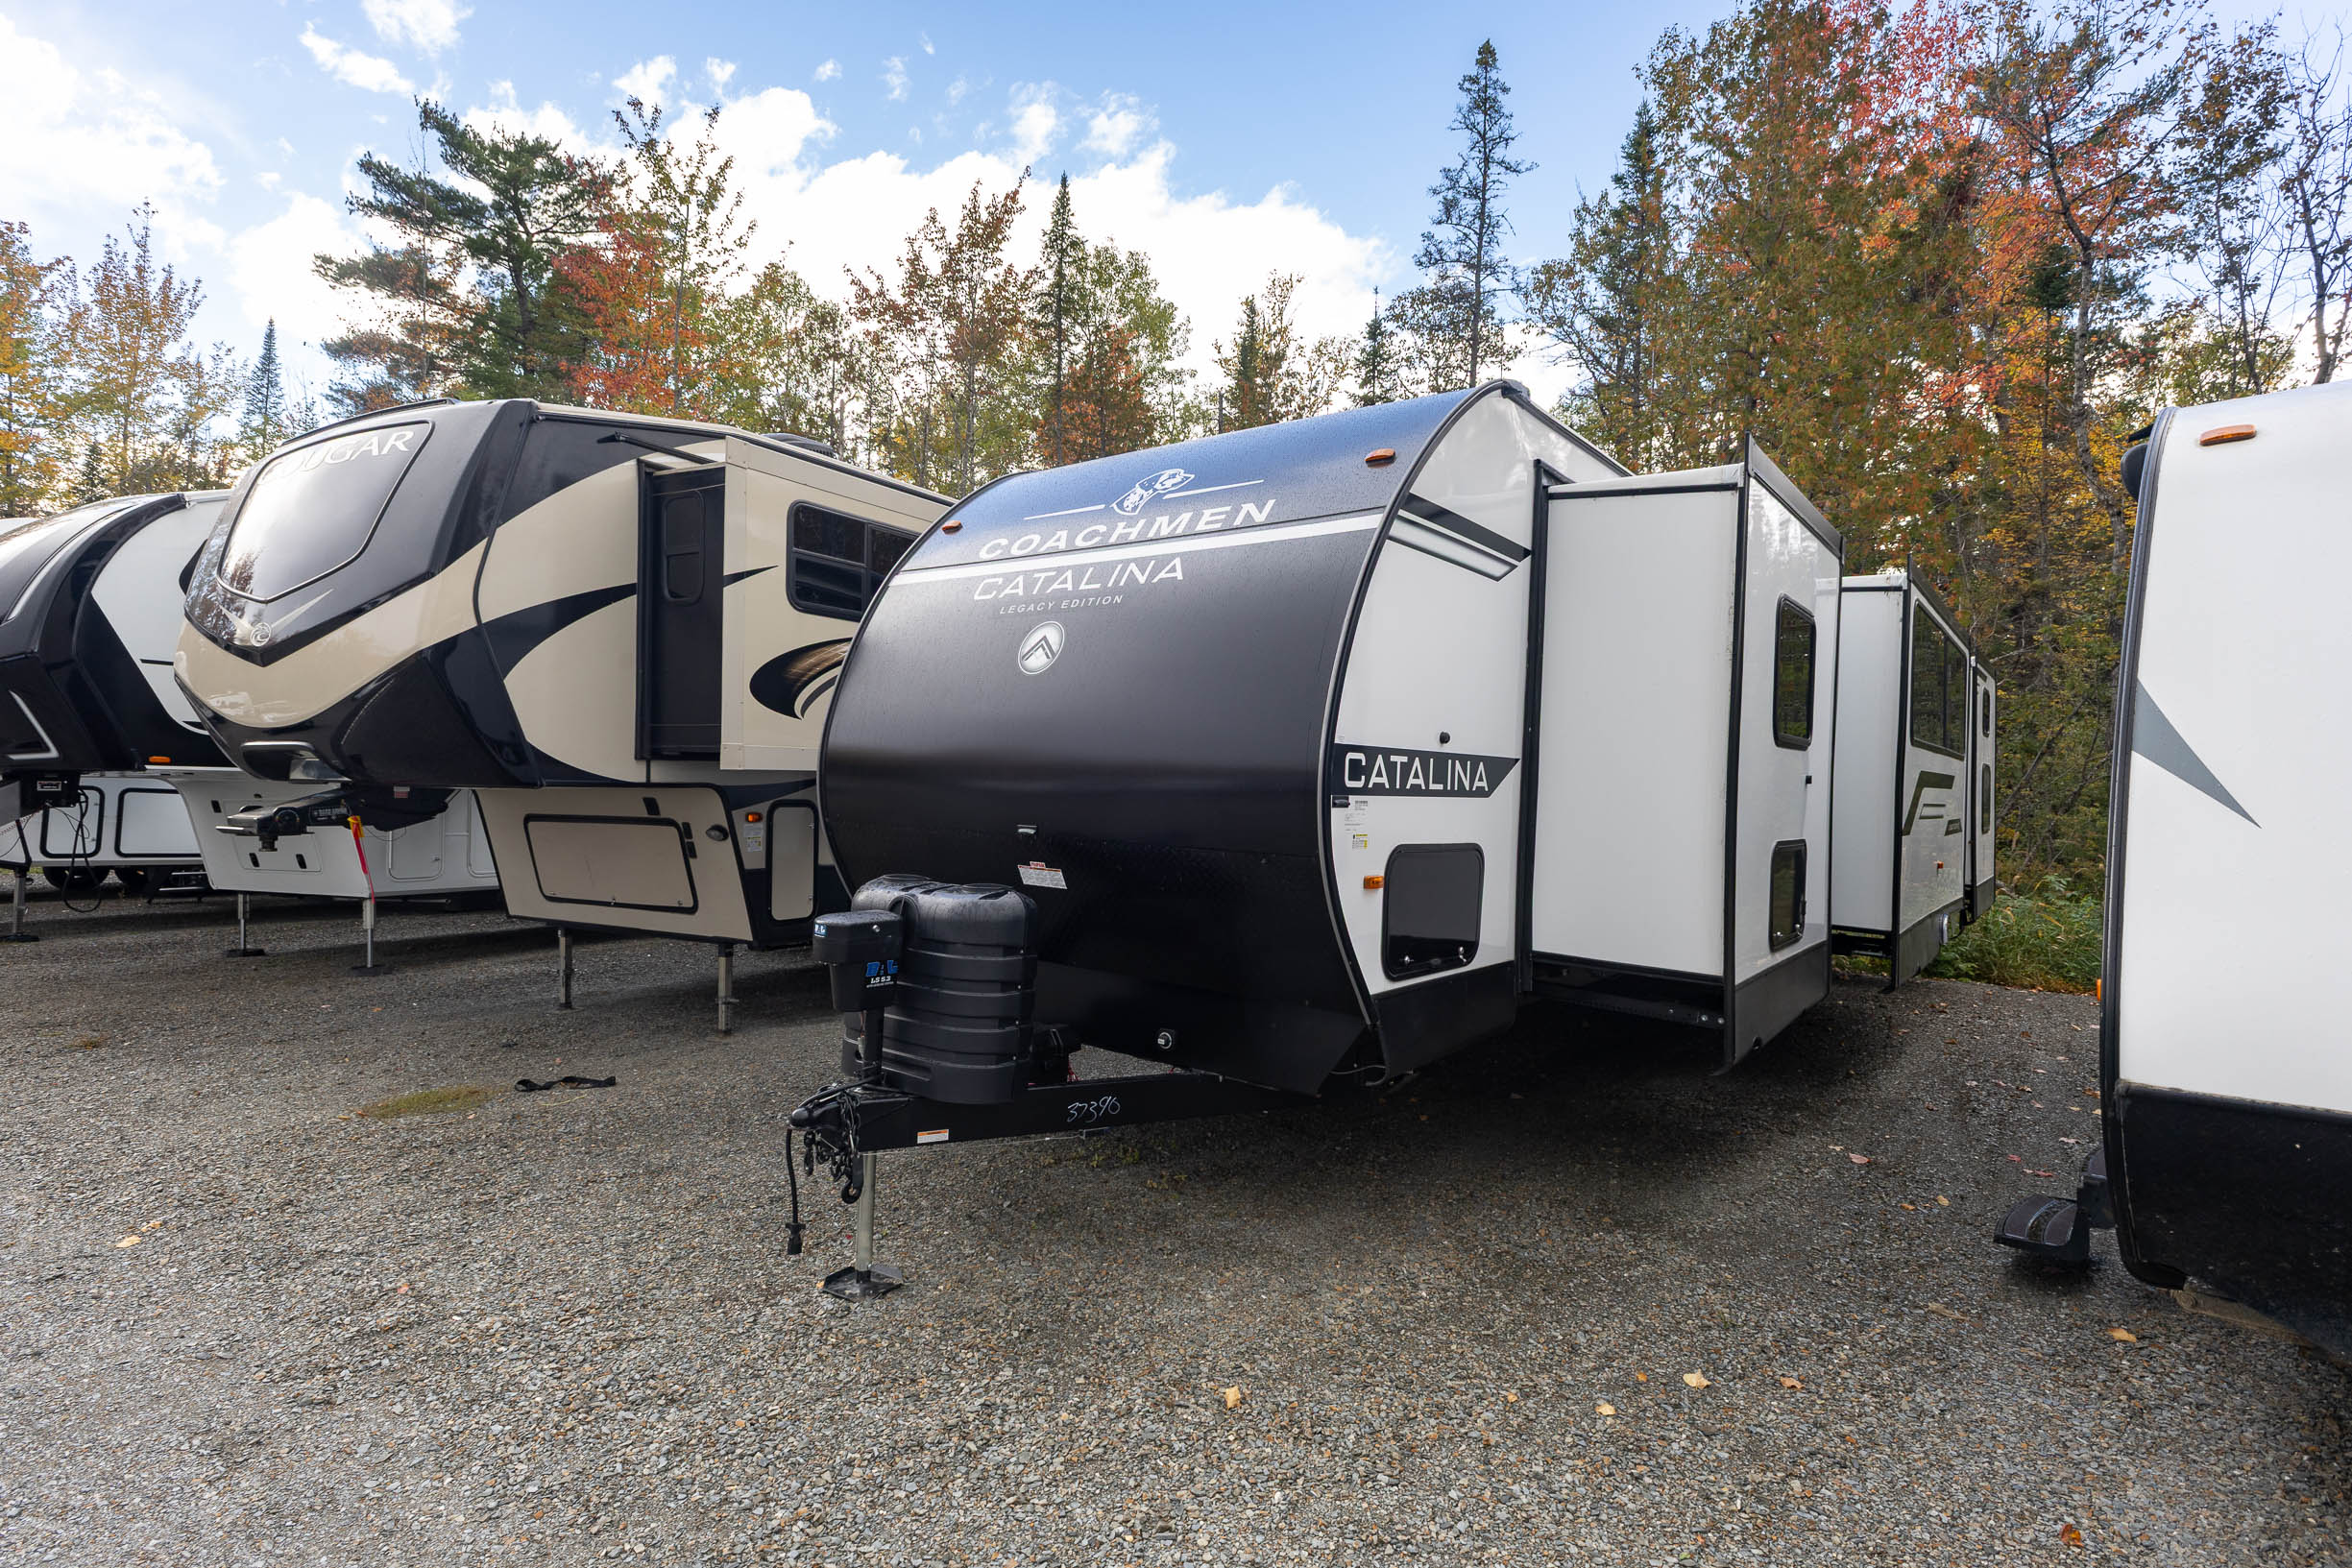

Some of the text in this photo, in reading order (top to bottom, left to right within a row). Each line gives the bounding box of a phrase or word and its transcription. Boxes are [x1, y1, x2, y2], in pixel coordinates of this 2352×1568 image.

[979, 498, 1276, 560] COACHMEN
[973, 557, 1184, 600] CATALINA
[1000, 594, 1123, 615] LEGACY EDITION
[1345, 752, 1489, 791] CATALINA
